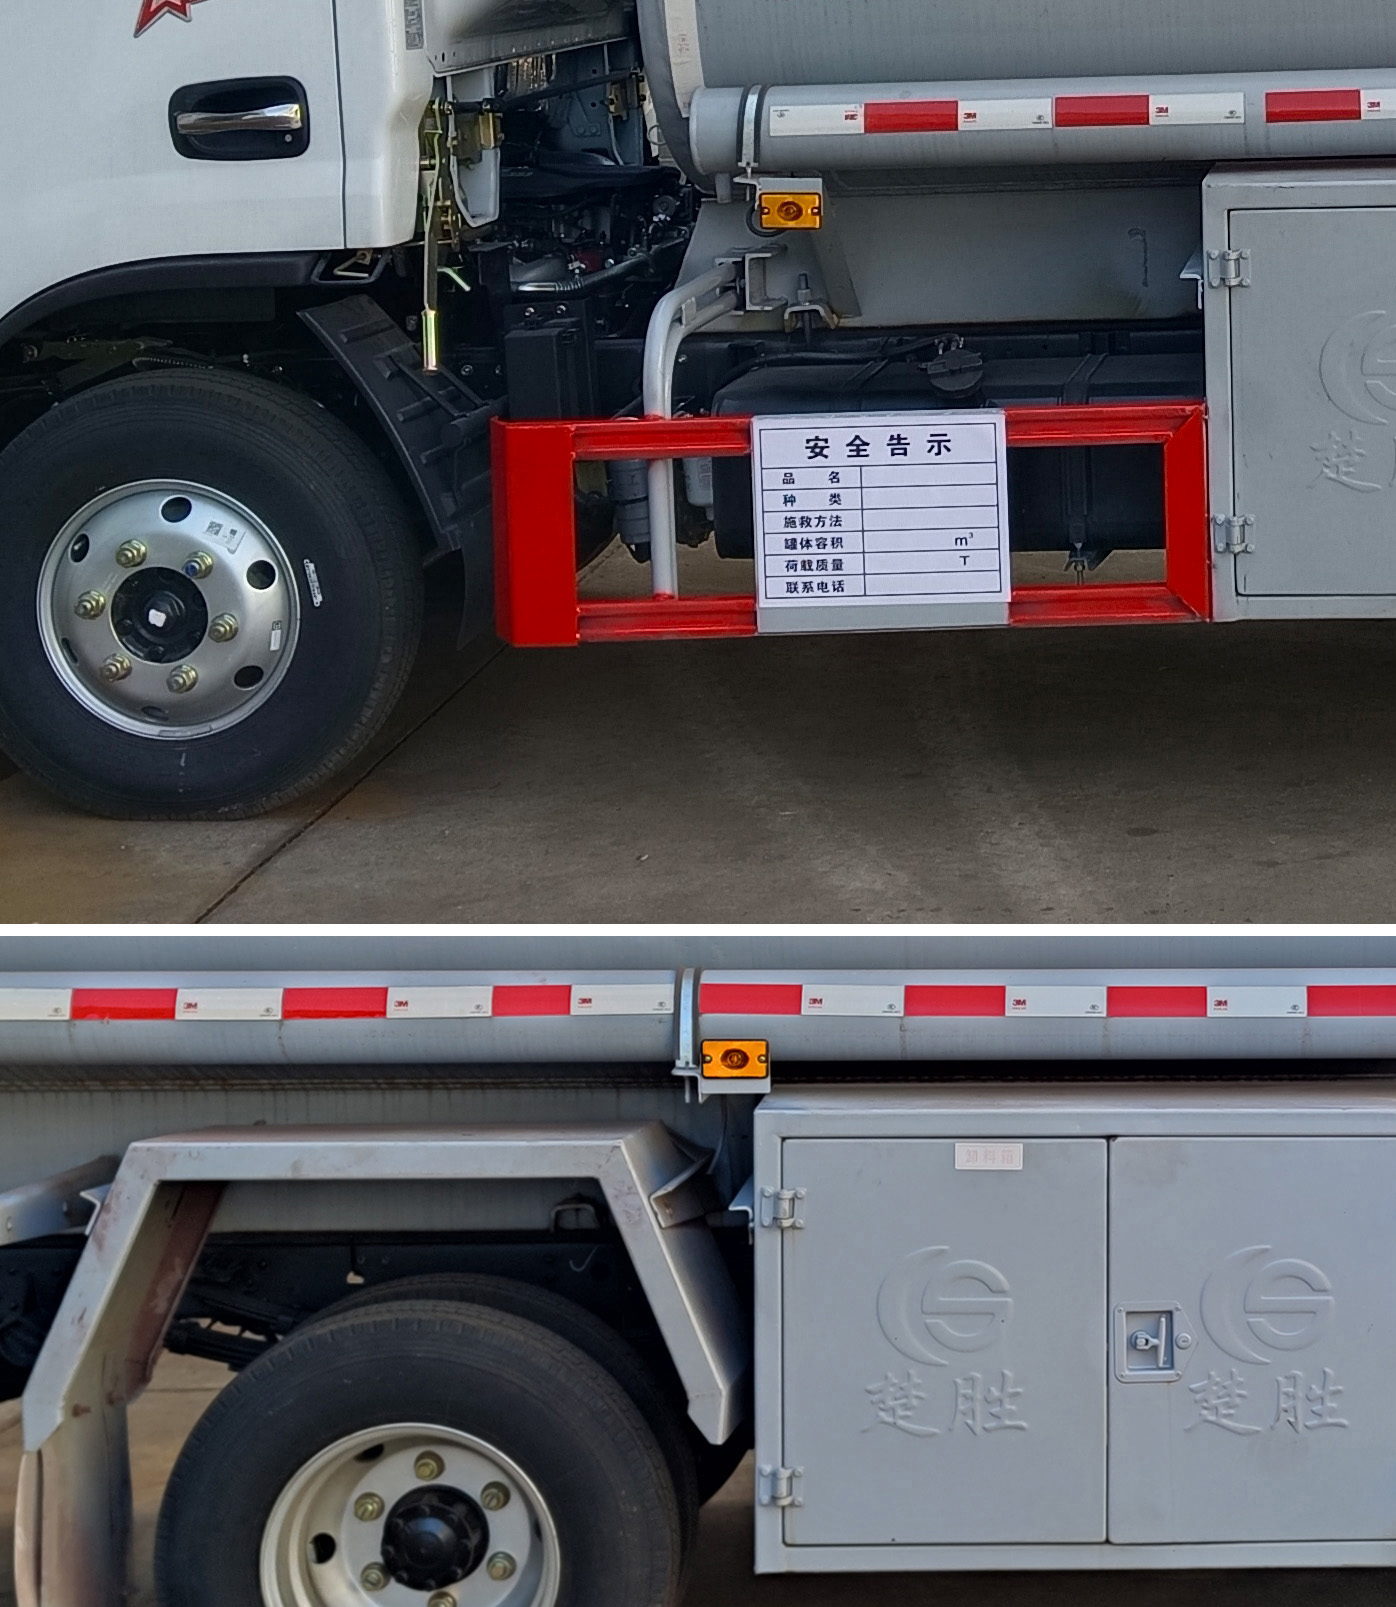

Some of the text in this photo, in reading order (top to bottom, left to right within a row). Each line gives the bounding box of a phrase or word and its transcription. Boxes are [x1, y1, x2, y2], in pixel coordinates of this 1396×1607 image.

[805, 433, 951, 459] 安全告示
[784, 515, 842, 528] 施救方法
[784, 537, 843, 550] 罐体容积
[785, 559, 844, 572] 荷载质量
[959, 556, 969, 565] T
[786, 580, 845, 594] 联系电话
[860, 1369, 1029, 1438] 楚胜
[1183, 1367, 1350, 1436] 楚胜
